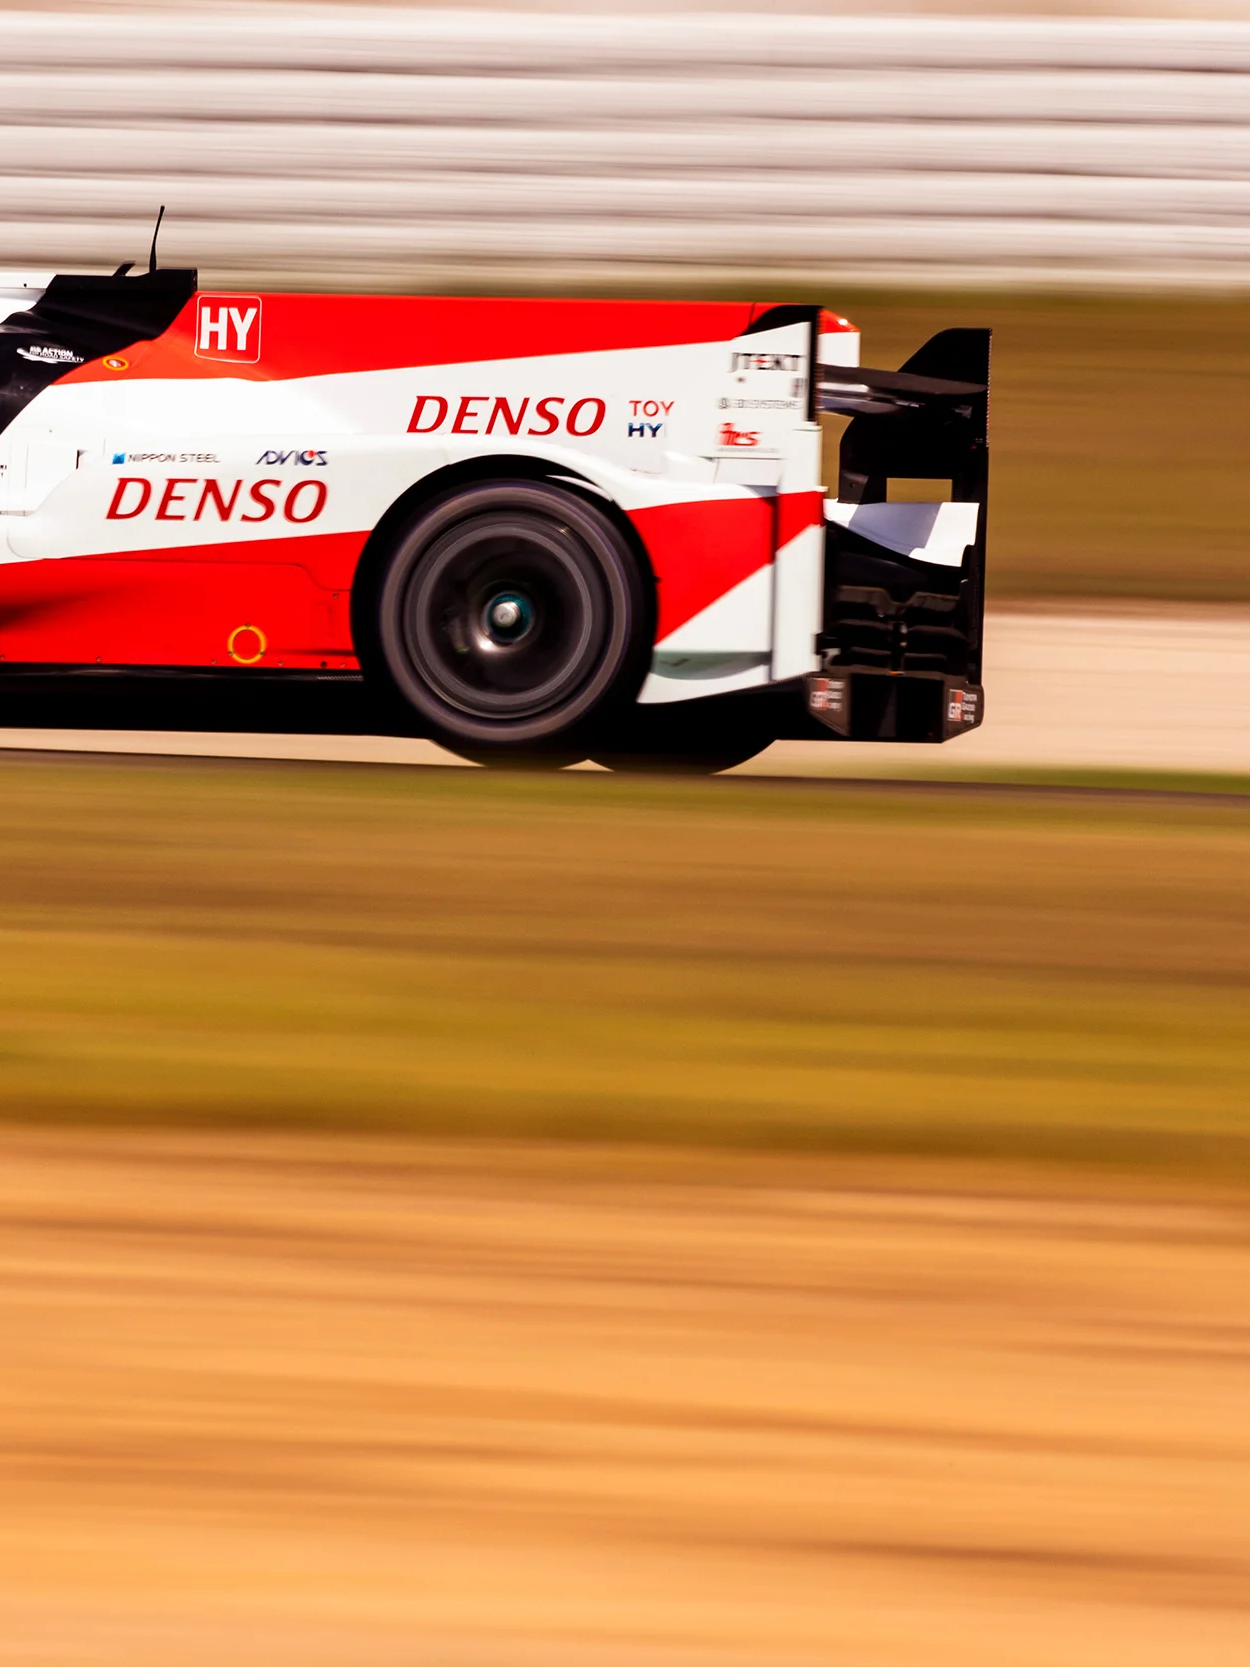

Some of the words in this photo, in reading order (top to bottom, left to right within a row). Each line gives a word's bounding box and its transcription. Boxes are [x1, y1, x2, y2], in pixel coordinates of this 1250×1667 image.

[200, 307, 258, 351] HY
[406, 395, 606, 437] DENSO
[629, 400, 675, 417] TOY
[627, 422, 664, 438] HY
[128, 453, 176, 463] NIPPON
[179, 453, 221, 463] STEEL
[255, 450, 328, 466] ADVICS
[105, 477, 328, 523] DENSO
